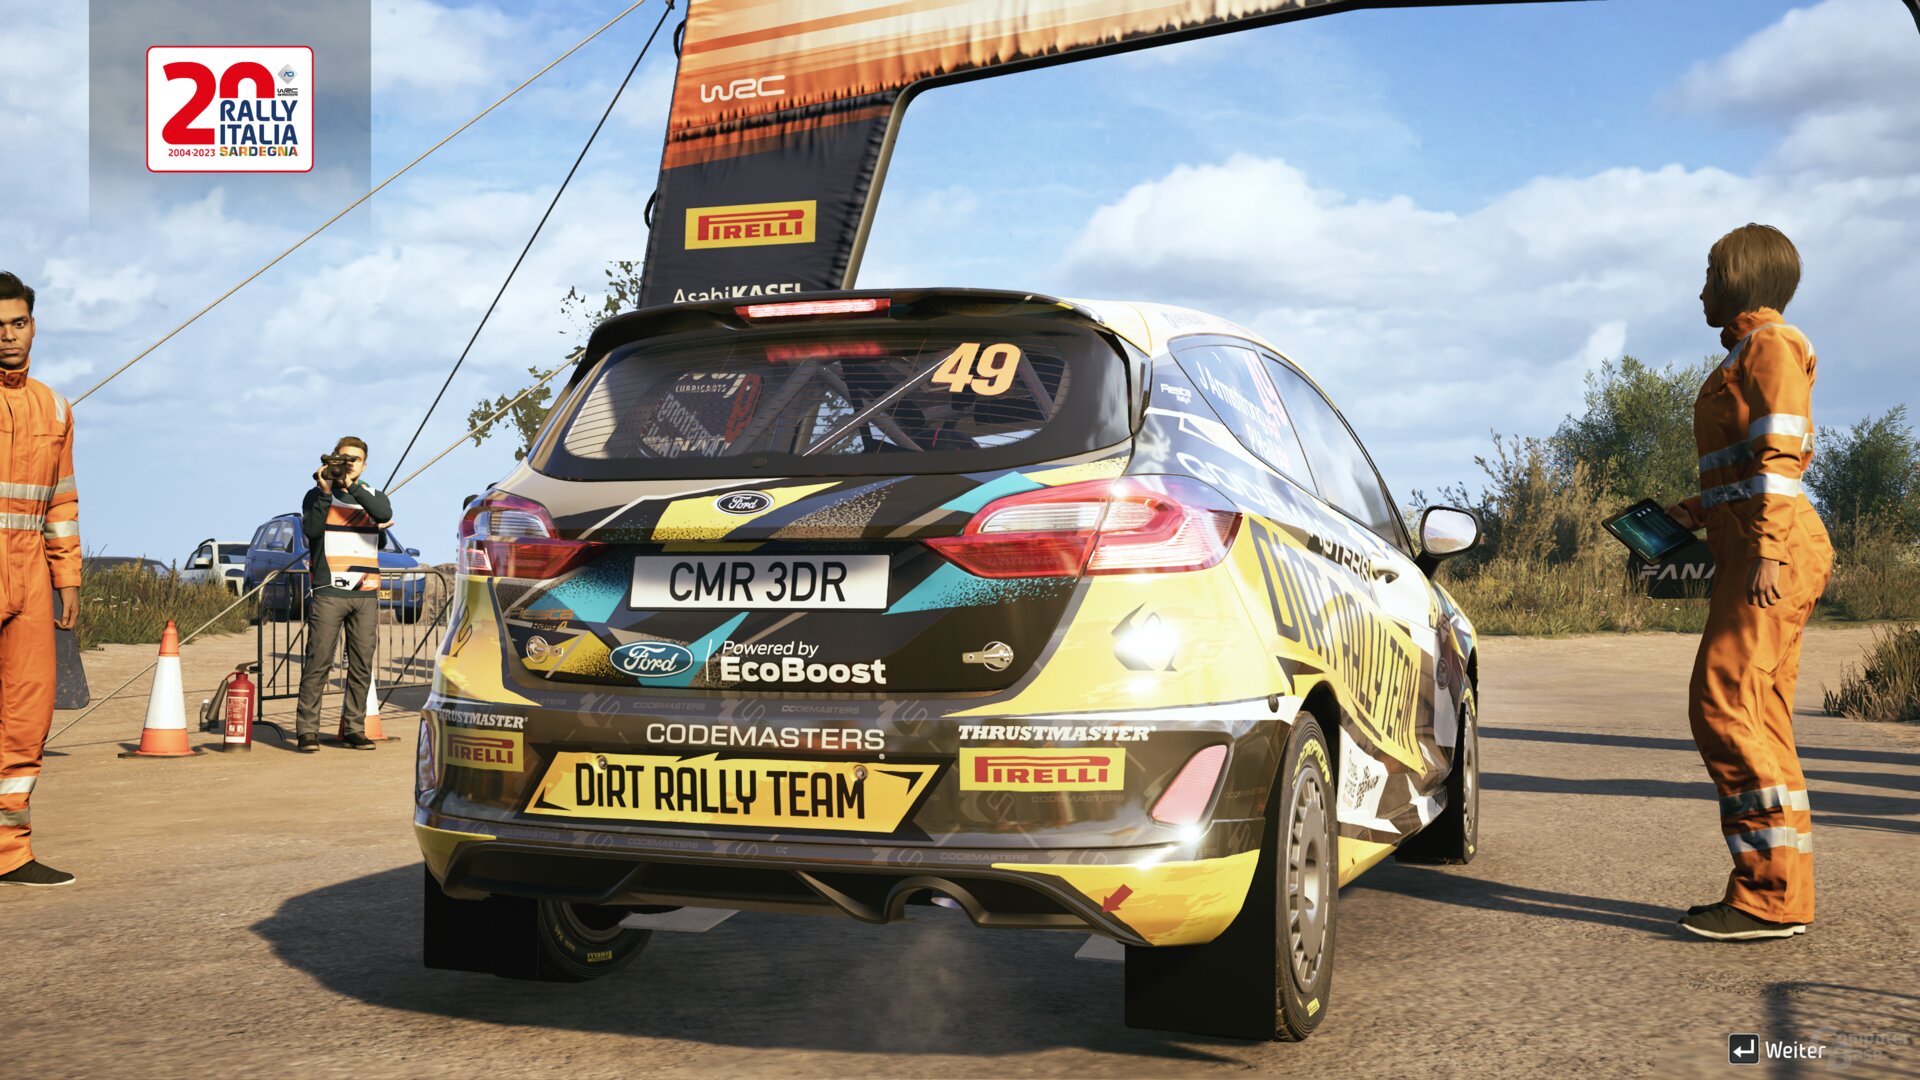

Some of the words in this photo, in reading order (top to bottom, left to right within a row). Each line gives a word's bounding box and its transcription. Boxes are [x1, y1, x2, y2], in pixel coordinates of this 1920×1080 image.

[701, 75, 785, 103] WRC
[698, 209, 804, 241] PIRELLI
[931, 342, 1021, 396] 49
[725, 495, 764, 512] Ford
[669, 561, 755, 602] CMR
[765, 561, 847, 602] 3DR
[623, 645, 679, 672] Ford
[722, 640, 794, 656] Powered
[798, 641, 819, 659] by
[721, 656, 887, 685] EcoBoost
[632, 702, 706, 710] CODEMASTERS
[782, 704, 860, 714] CODEMASTERS
[646, 723, 885, 750] CODEMASTERS
[958, 725, 1150, 741] THRUSTMASTER
[448, 733, 514, 764] PIRELLI
[974, 756, 1111, 783] PIRELLI
[654, 766, 757, 815] RALLY
[766, 769, 865, 820] TEAM
[1031, 794, 1125, 803] CODEMASTERS
[627, 838, 699, 849] CODEMASTERS
[940, 851, 1028, 862] CODEMASTERS
